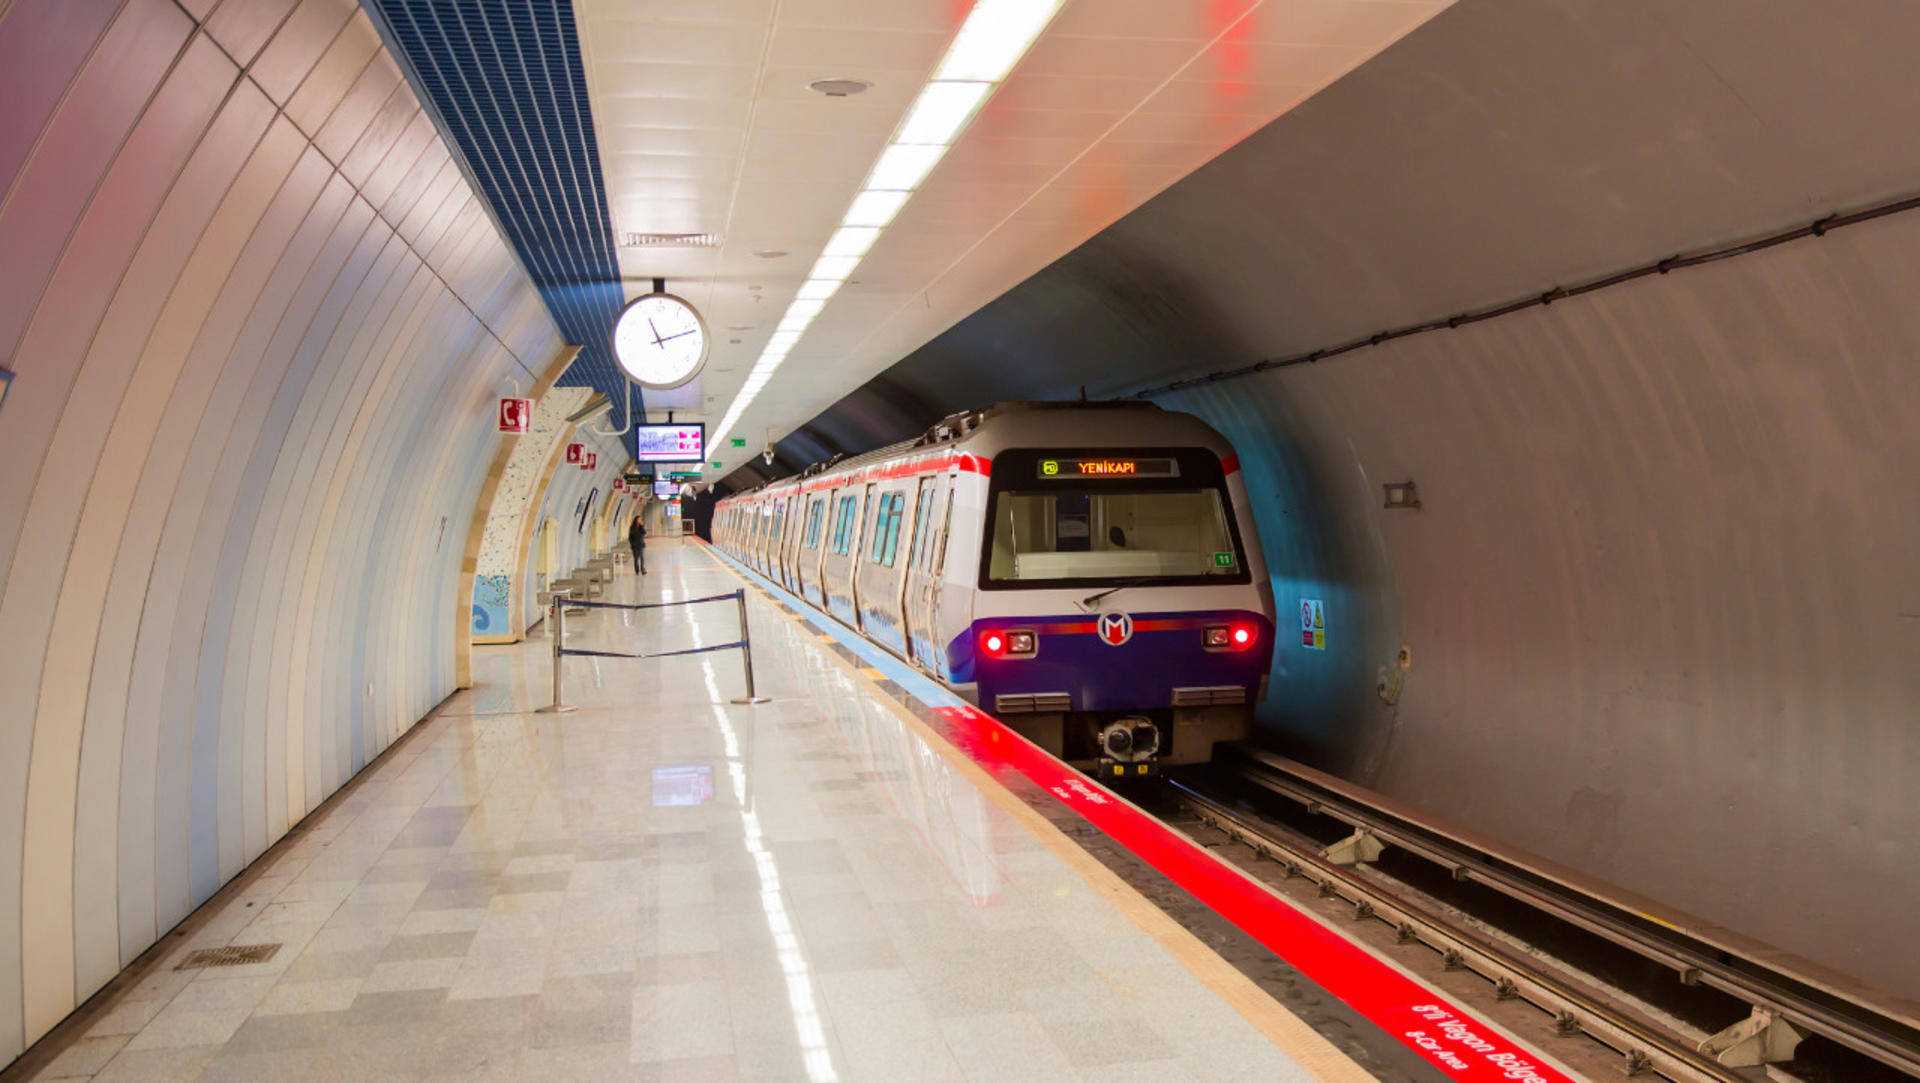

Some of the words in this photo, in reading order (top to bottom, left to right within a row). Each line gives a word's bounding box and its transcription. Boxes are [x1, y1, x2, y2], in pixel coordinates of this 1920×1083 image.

[1078, 460, 1135, 474] YENİKAPI
[1219, 555, 1230, 564] 11
[1105, 616, 1126, 638] M
[1437, 1019, 1496, 1053] Vagon
[1433, 1051, 1469, 1070] Area
